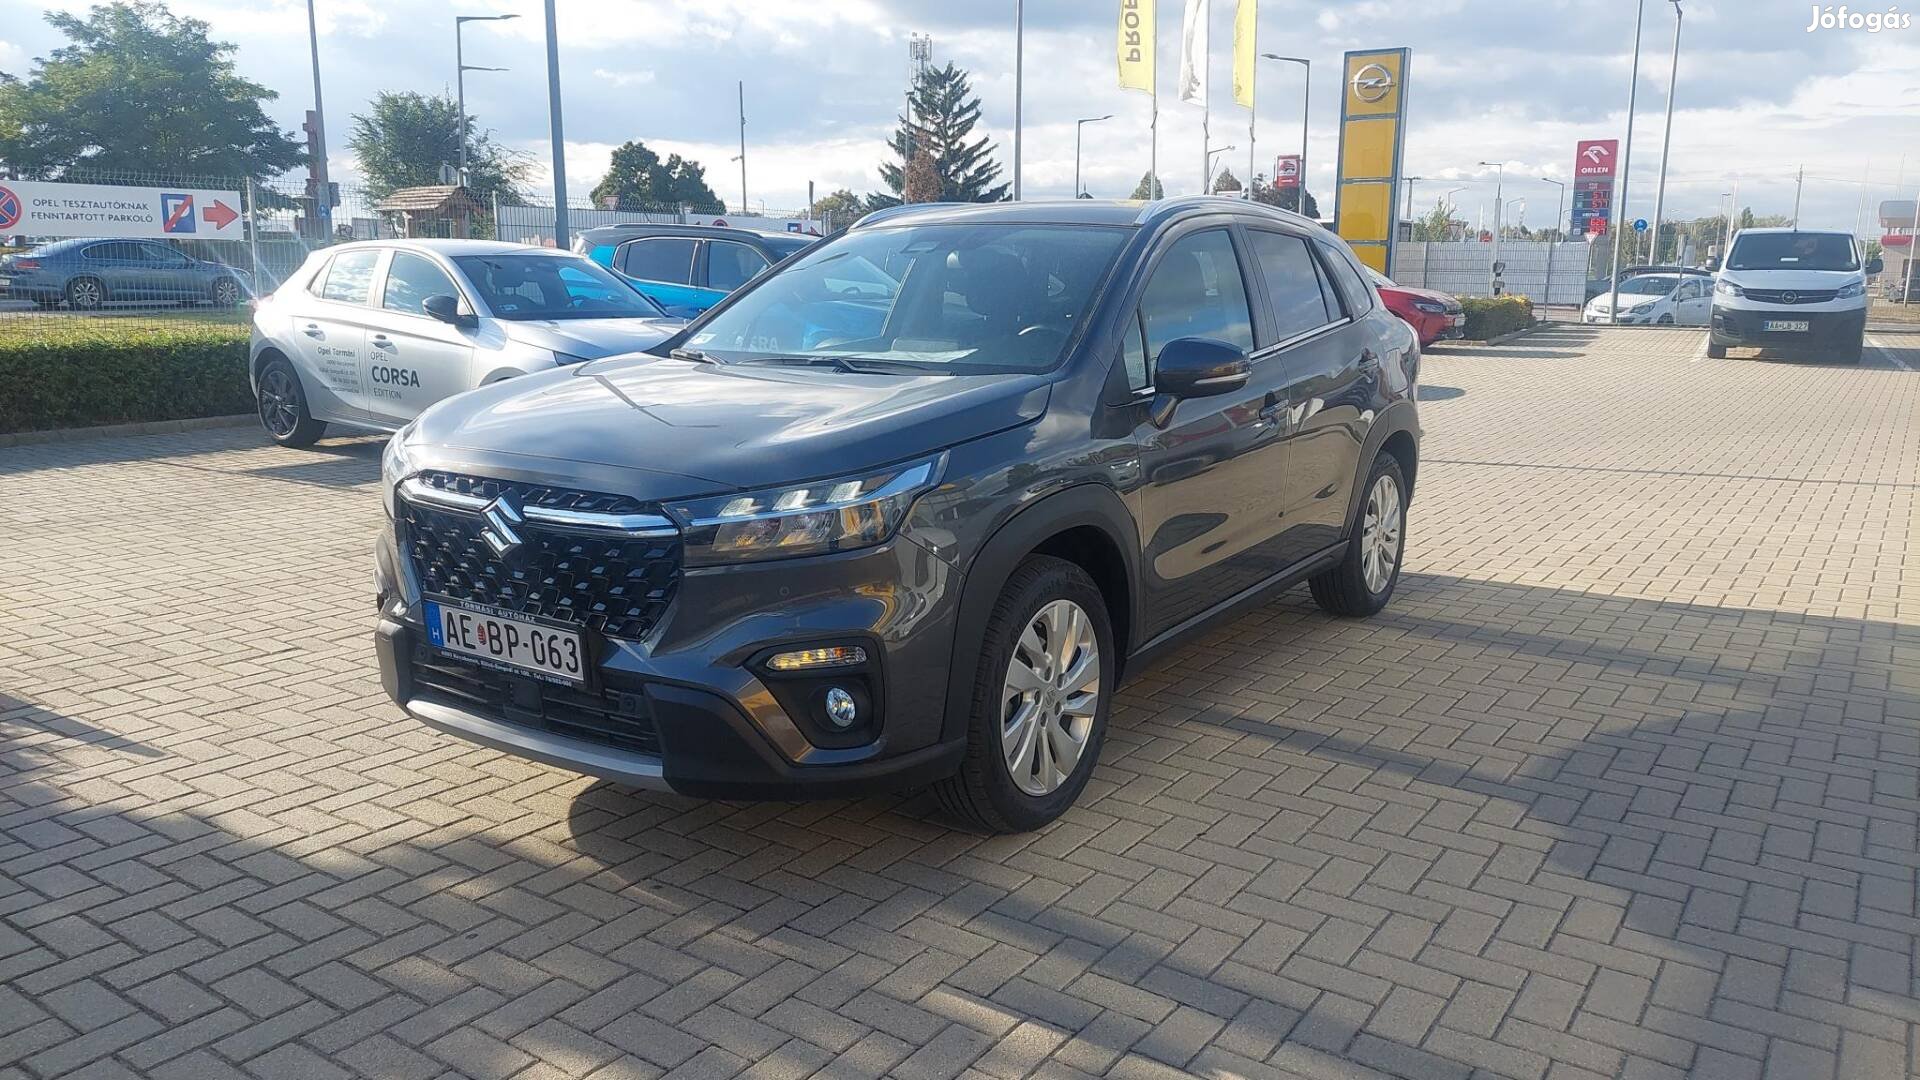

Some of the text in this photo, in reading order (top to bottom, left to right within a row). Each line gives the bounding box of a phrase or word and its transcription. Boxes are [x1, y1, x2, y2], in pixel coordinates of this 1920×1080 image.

[32, 199, 59, 208] OPEL
[31, 211, 153, 223] FENNTARTOTT PARKOLÓ
[317, 346, 331, 356] Opel
[370, 351, 389, 362] OPEL
[371, 365, 420, 388] CORSA
[373, 387, 402, 400] EDITION
[431, 627, 440, 640] H
[446, 611, 579, 674] AE BP-063
